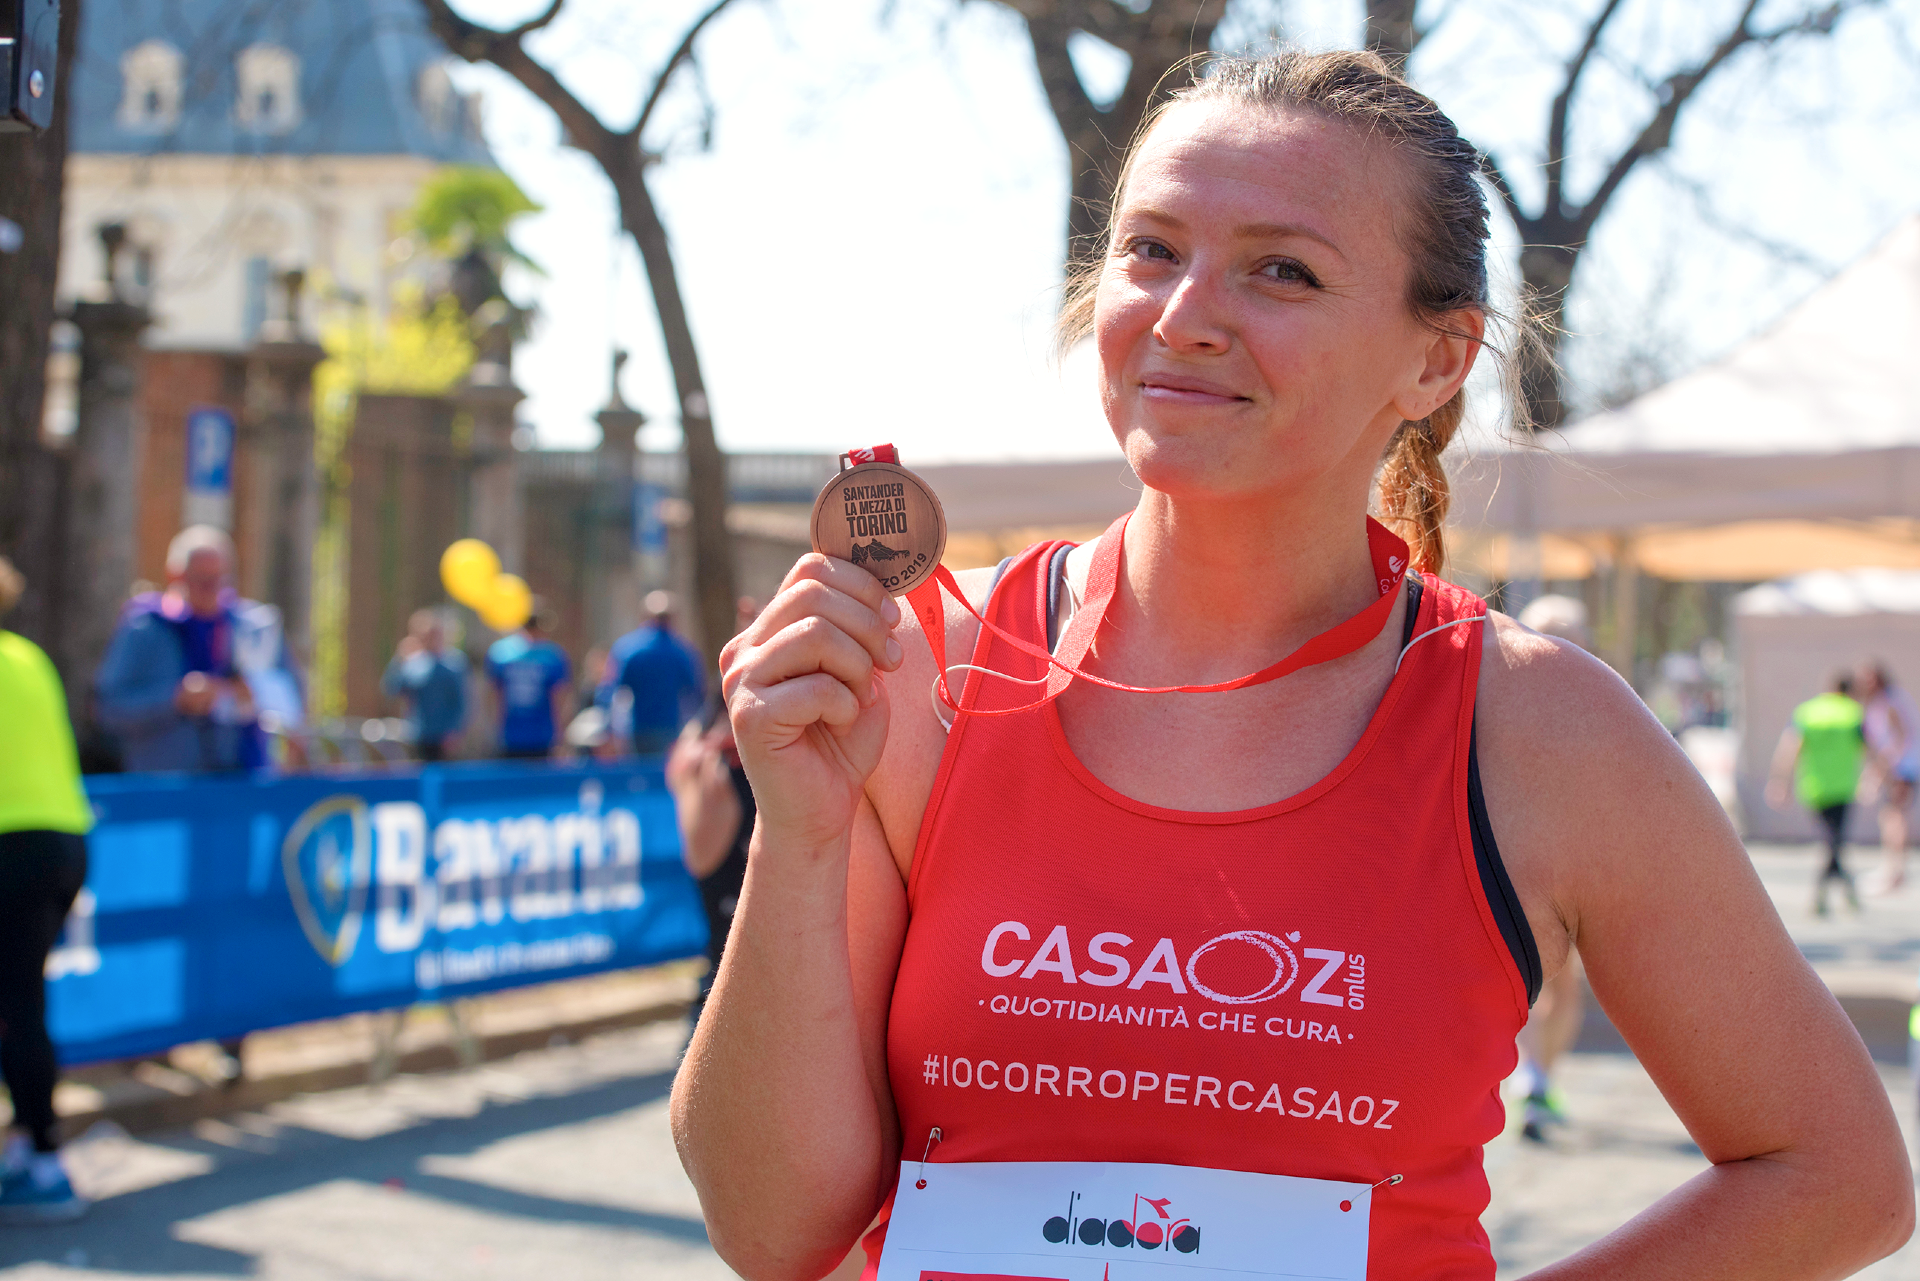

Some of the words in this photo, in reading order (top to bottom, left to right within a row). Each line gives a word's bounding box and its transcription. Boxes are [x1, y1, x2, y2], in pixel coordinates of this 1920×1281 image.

[843, 482, 904, 502] SANTANDER
[845, 502, 857, 516] LA
[859, 499, 893, 515] MEZZA
[895, 498, 906, 512] DI
[846, 511, 907, 538] TORINO
[900, 552, 927, 581] 2019
[373, 778, 645, 954] Bavaria
[1343, 953, 1366, 1011] onlus
[1198, 1011, 1257, 1034] CHE
[922, 1053, 1400, 1130] #IOCORROPERCASAOZ
[1042, 1190, 1201, 1255] diadora
